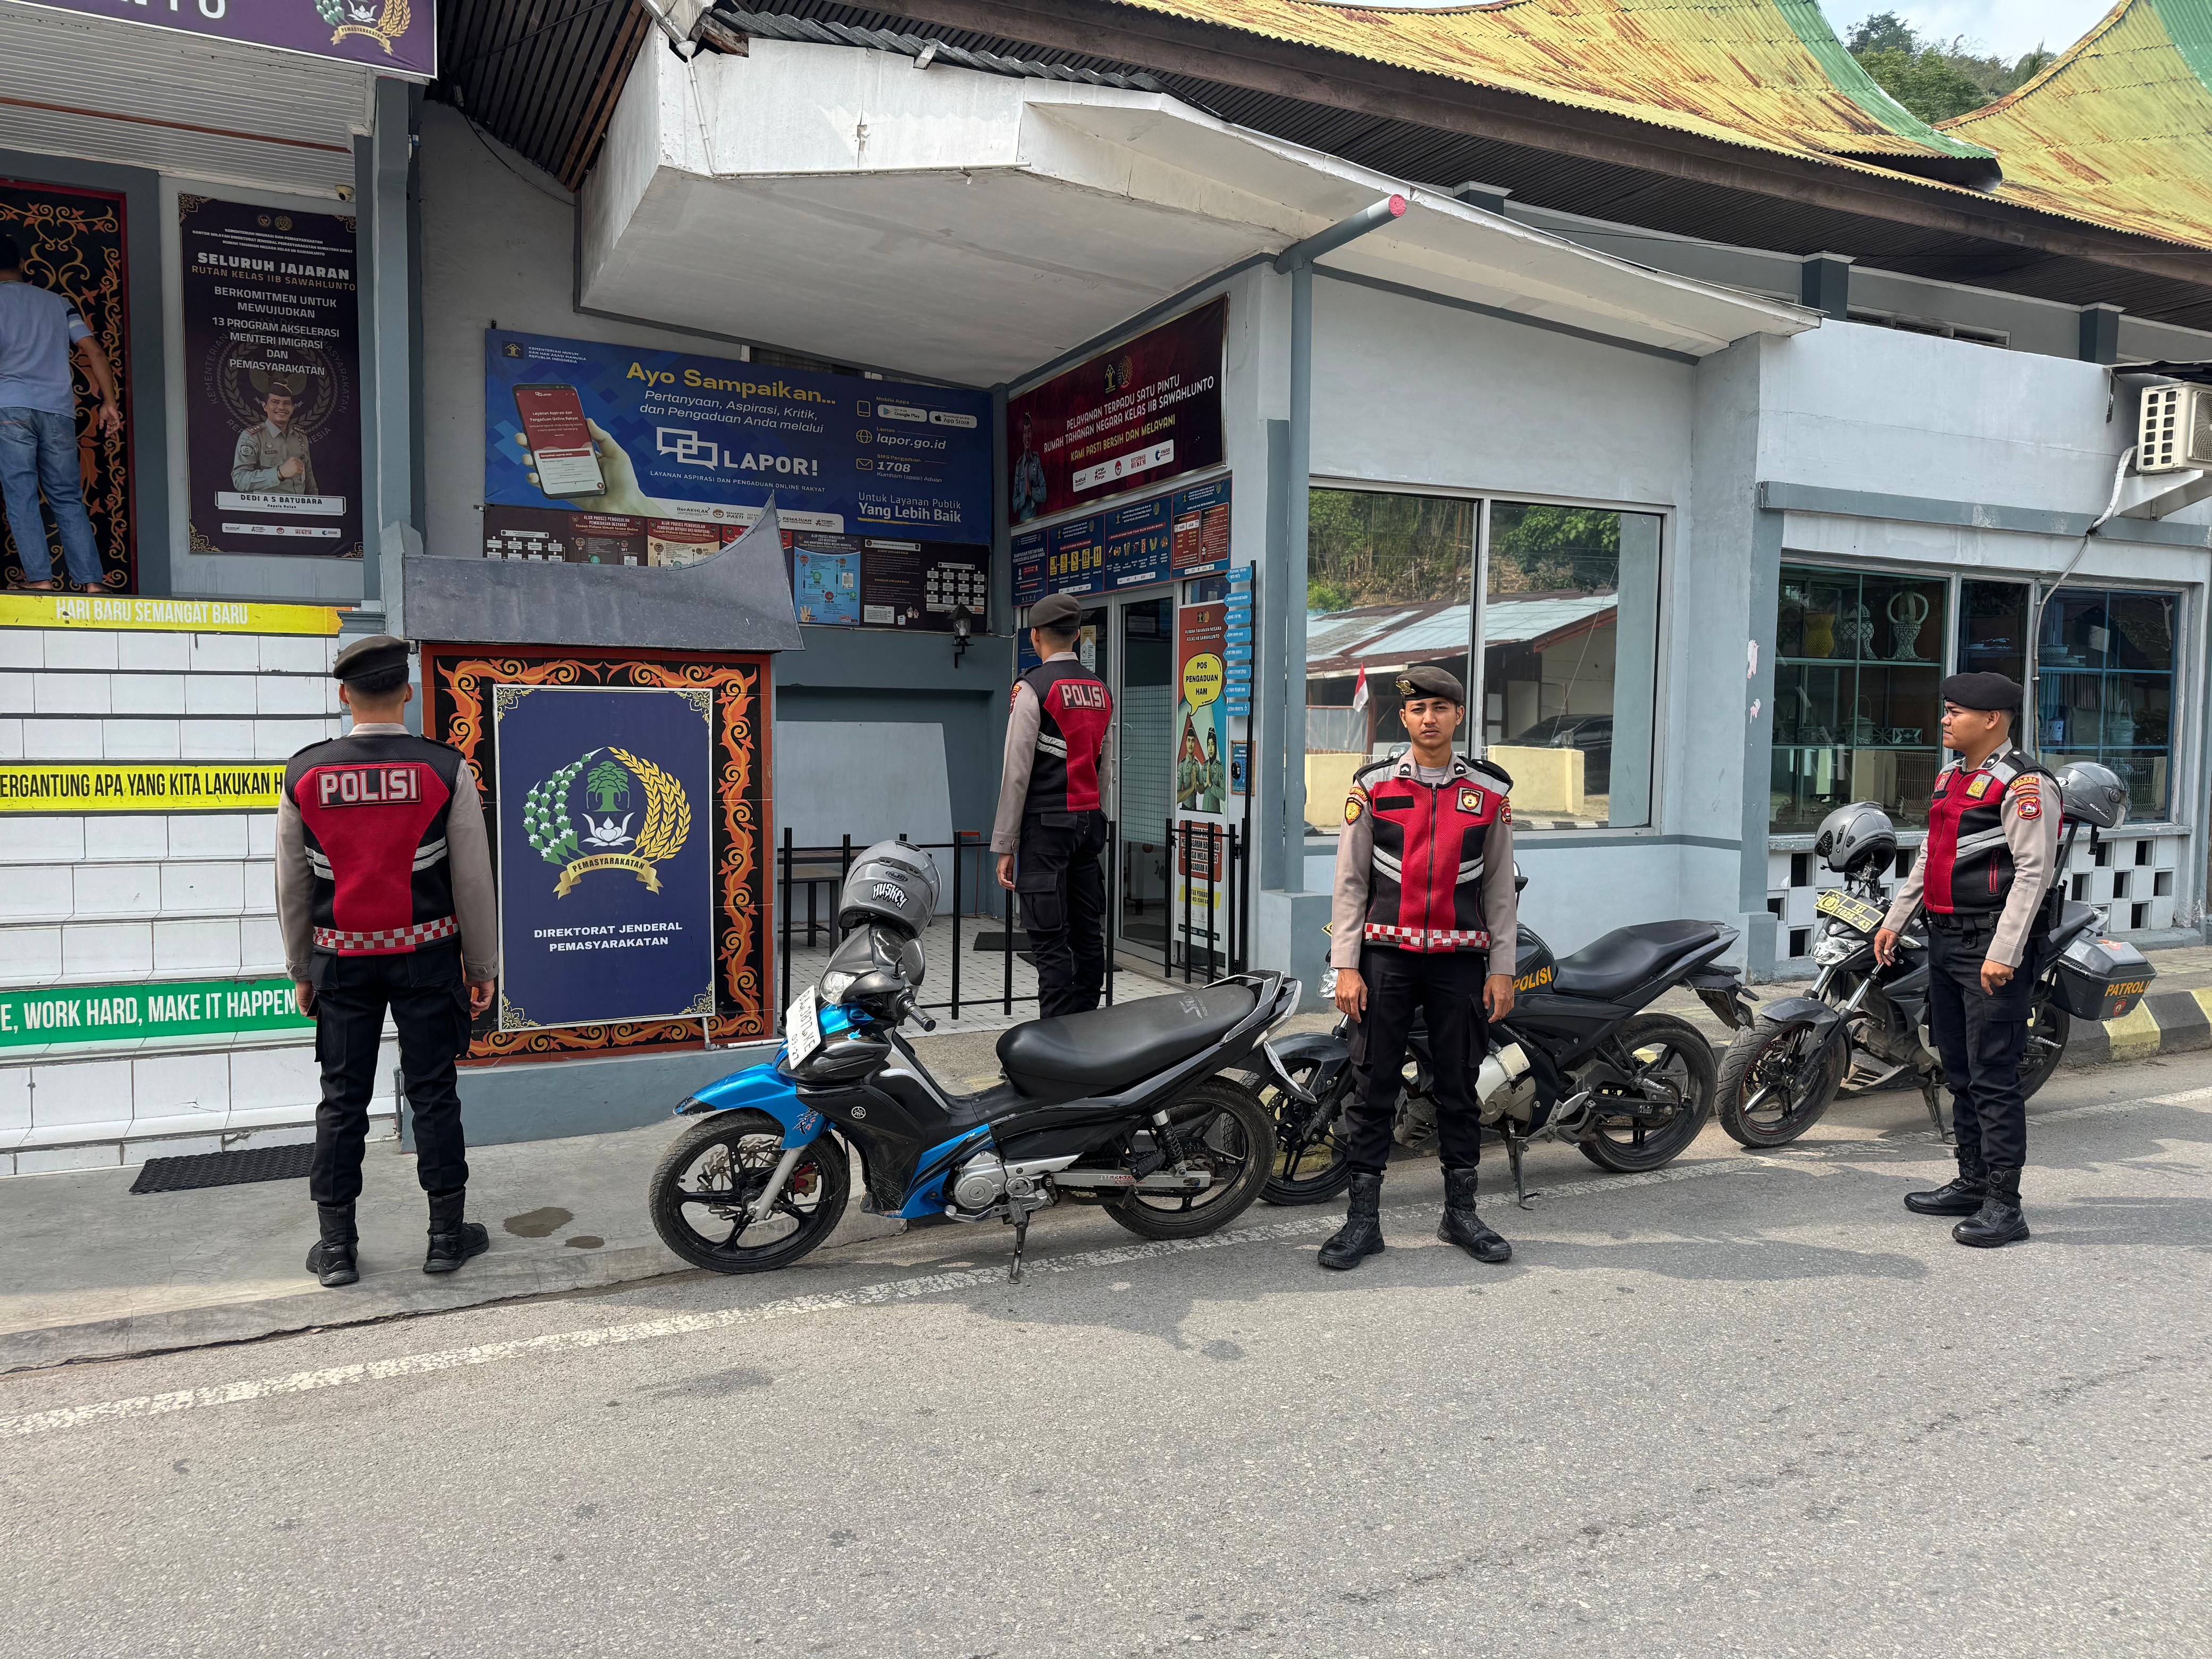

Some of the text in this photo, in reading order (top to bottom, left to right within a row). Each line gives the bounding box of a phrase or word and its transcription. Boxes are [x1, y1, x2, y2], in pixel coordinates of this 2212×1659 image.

[198, 253, 349, 280] SELURUH JAJARAN
[191, 265, 228, 277] RUTAN
[232, 271, 264, 281] KELAS
[285, 277, 356, 291] SAWAHLUNTO
[214, 286, 337, 308] BERKOMITMEN UNTUK
[237, 302, 315, 319] MEWUJUDKAN
[212, 317, 339, 338] 13 PROGRAM AKSELERASI
[230, 332, 323, 349] MENTERI IMIGRASI
[266, 349, 288, 359] DAN
[230, 359, 325, 375] PEMASYARAKATAN
[626, 362, 836, 404] Ayo Sampaikan...
[645, 390, 817, 421] Pertanyaan, Aspirasi, Kritik,
[1066, 373, 1180, 431] PELAYANAN TERPADU SATU PINTU
[640, 404, 824, 433] dan Pengaduan Anda melalui
[1044, 375, 1214, 454] RUMAH TAHANAN NEGARA KELAS IIB SAWAHLUNTO
[877, 433, 946, 449] lapor.go.id
[1070, 414, 1175, 462] KAMI PASTI BERSIH DAN MELAYANI
[724, 450, 818, 476] LAPOR!
[877, 461, 911, 472] 1708
[733, 479, 773, 488] PENGADUAN
[279, 496, 323, 505] BATUBARA
[858, 491, 961, 509] Untuk Layanan Publik
[858, 502, 961, 523] Yang Lebih Baik
[56, 599, 248, 624] HARI BARU SEMANGAT BARU
[1186, 674, 1218, 683] PENGADUAN
[1063, 684, 1106, 708] POLISI
[0, 773, 271, 798] ERGANTUNG APA YANG KITA LAKUKAN
[319, 769, 416, 805] POLISI
[572, 857, 645, 873] PEMASYARAKATAN
[534, 922, 683, 938] DIREKTORAT JENDERAL
[549, 937, 668, 952] PEMASYARAKATAN
[1513, 965, 1553, 991] POLISI
[2104, 980, 2151, 996] PATROLI
[23, 989, 296, 1030] WORK HARD, MAKE IT HAPPEN
[803, 1032, 815, 1052] KE
[1502, 1024, 1536, 1050] DELTABOX
